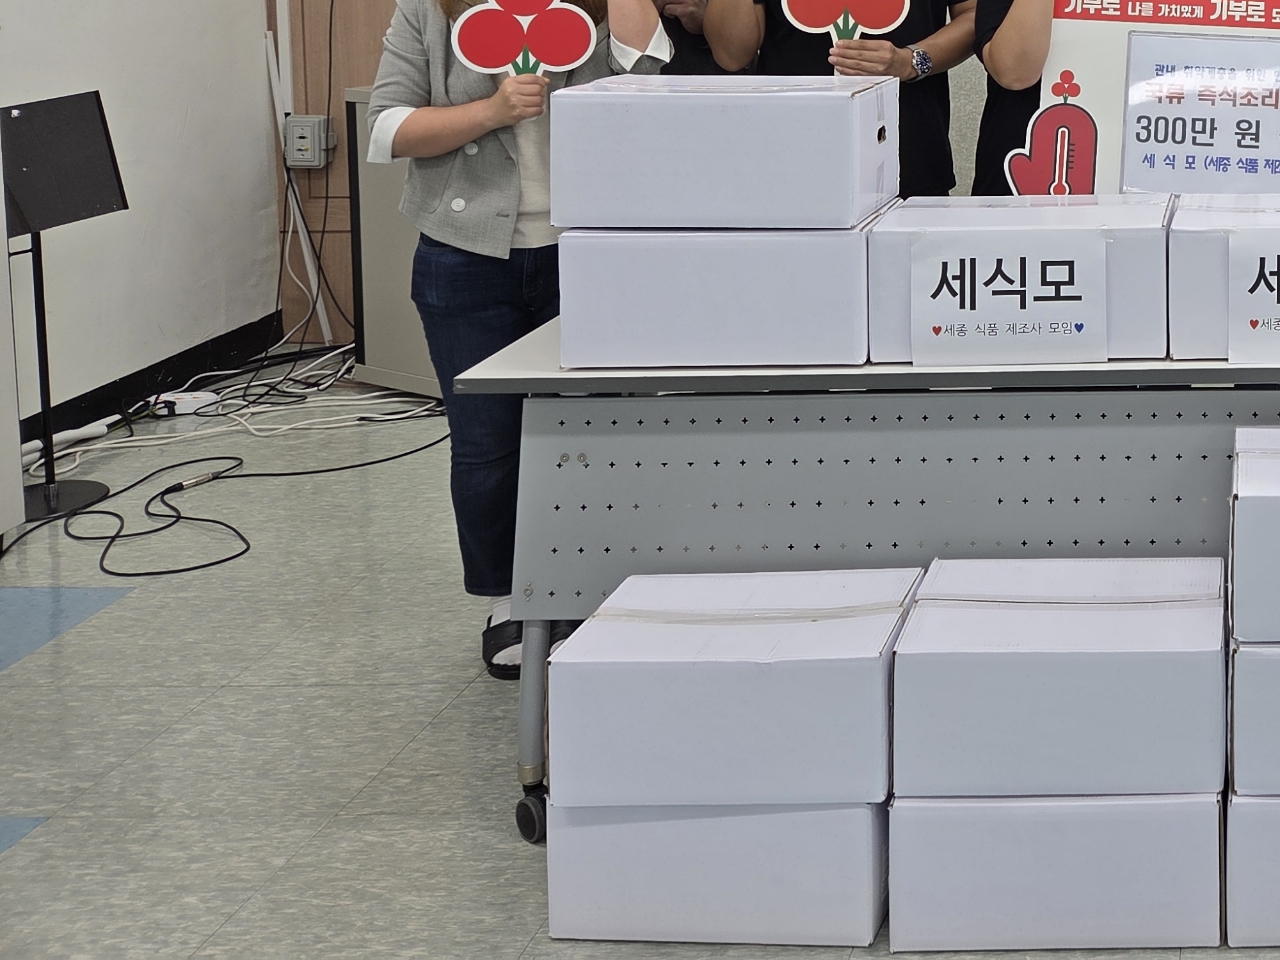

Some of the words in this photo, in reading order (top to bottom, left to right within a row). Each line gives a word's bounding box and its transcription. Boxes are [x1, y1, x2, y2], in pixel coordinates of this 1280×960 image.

[1127, 1, 1154, 17] 나를
[1157, 3, 1204, 18] 가치있게
[1209, 0, 1266, 22] 기부로
[1154, 63, 1176, 77] 관내
[1197, 85, 1280, 110] 즉석조리
[1135, 115, 1218, 147] 300만
[1234, 119, 1261, 149] 원
[1203, 155, 1231, 173] (세종
[1236, 157, 1260, 174] 식품
[930, 256, 1083, 311] 세식모
[943, 323, 969, 338] 세종
[974, 322, 999, 337] 식품
[1005, 322, 1042, 336] 제조사
[1048, 321, 1073, 336] 모임
